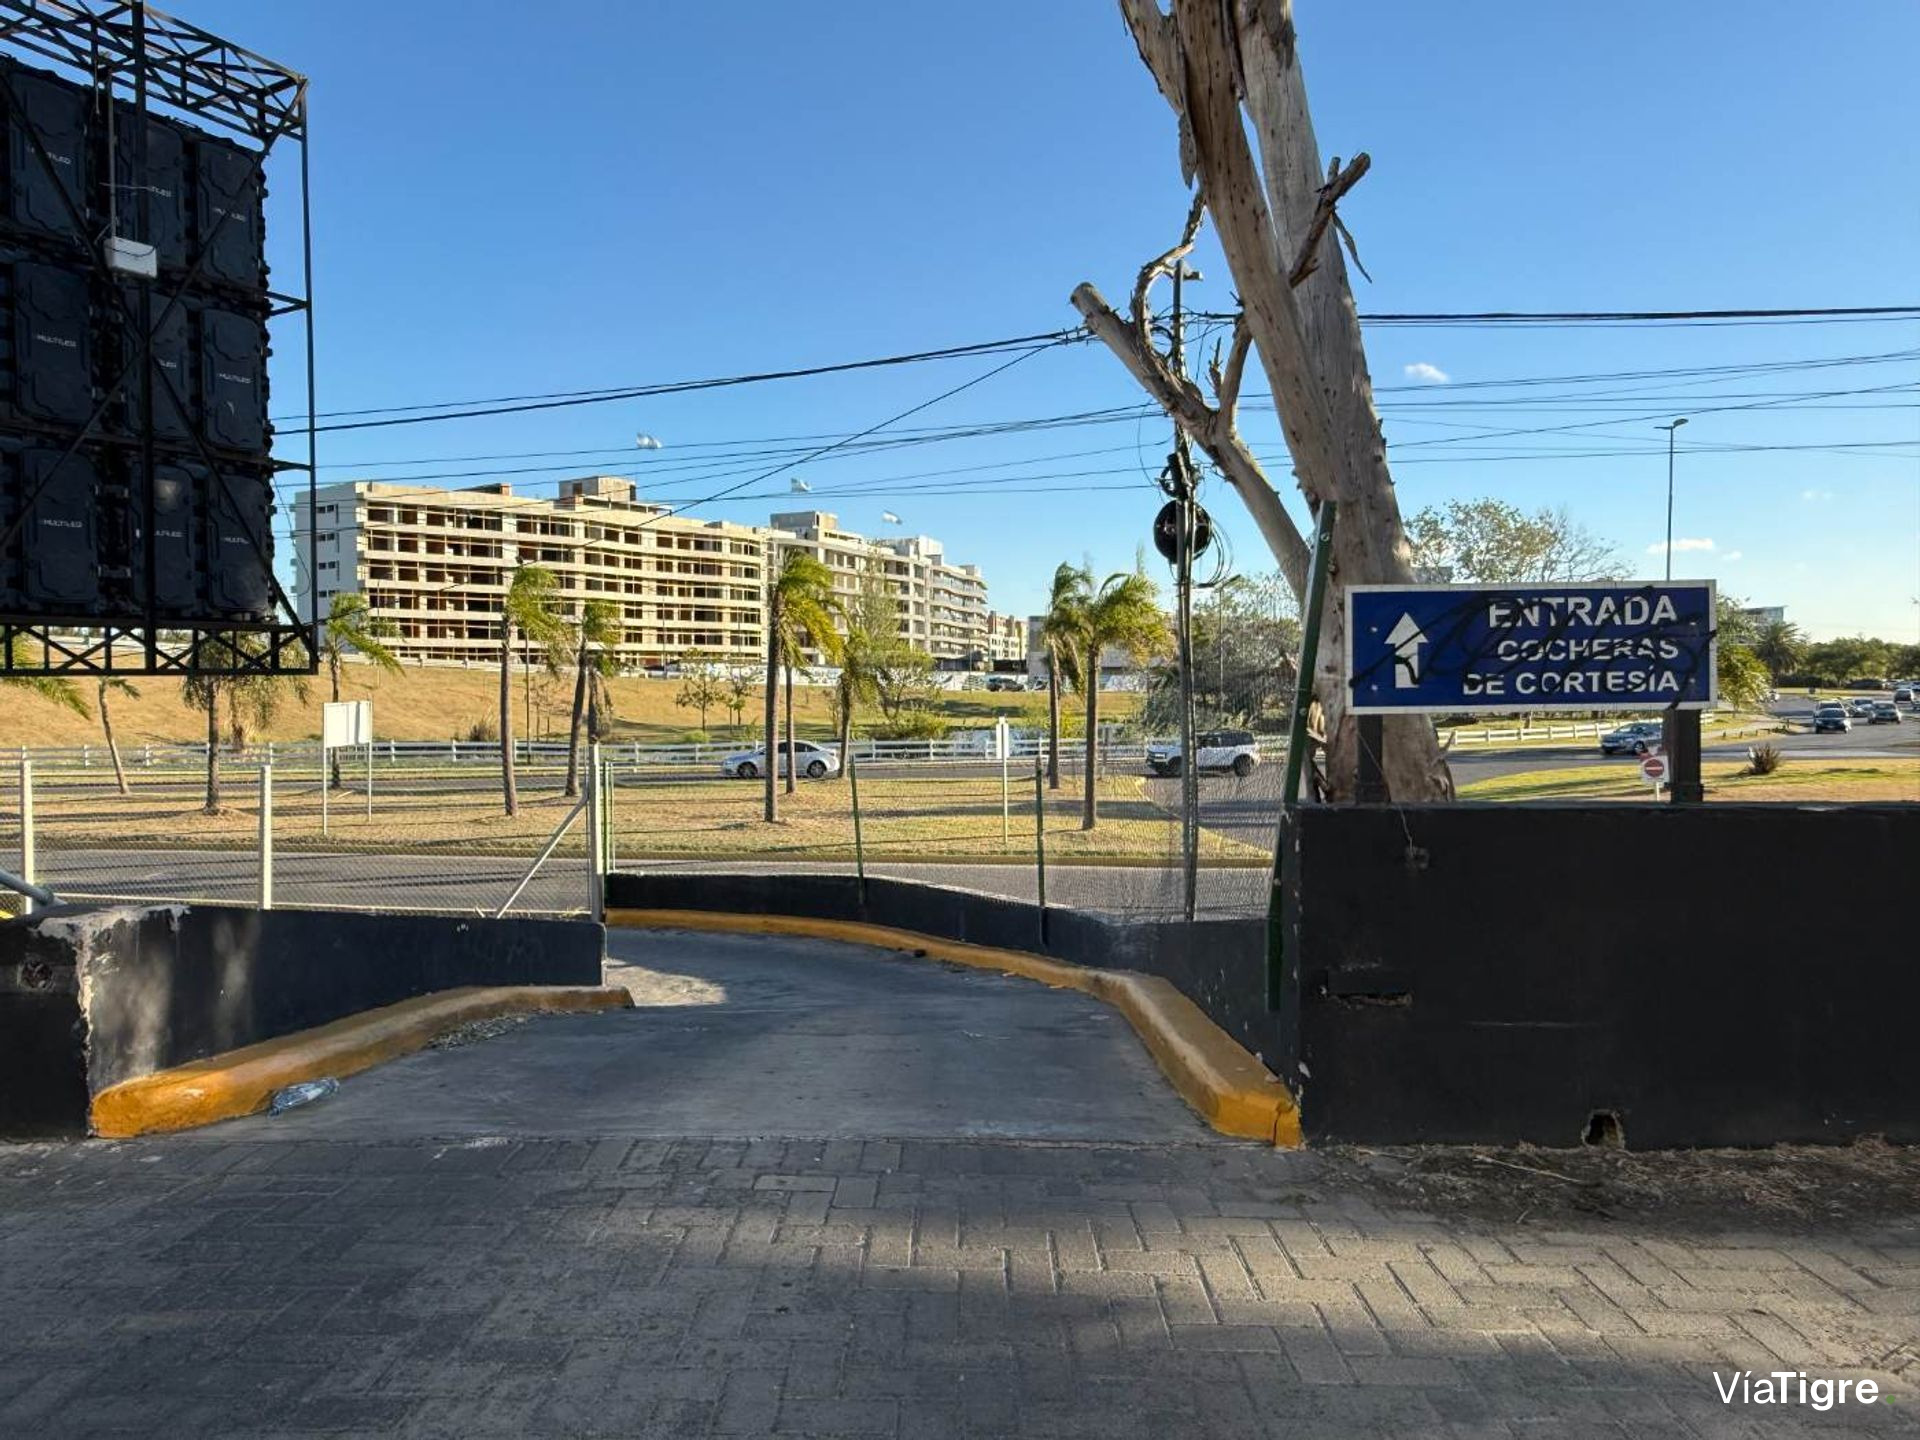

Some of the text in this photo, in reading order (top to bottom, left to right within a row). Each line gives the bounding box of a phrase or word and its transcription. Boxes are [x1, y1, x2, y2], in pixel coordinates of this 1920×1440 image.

[1489, 595, 1678, 628] ENTRADA
[1498, 638, 1679, 661] COCHERAS
[1463, 665, 1680, 695] DE CORTESÍA
